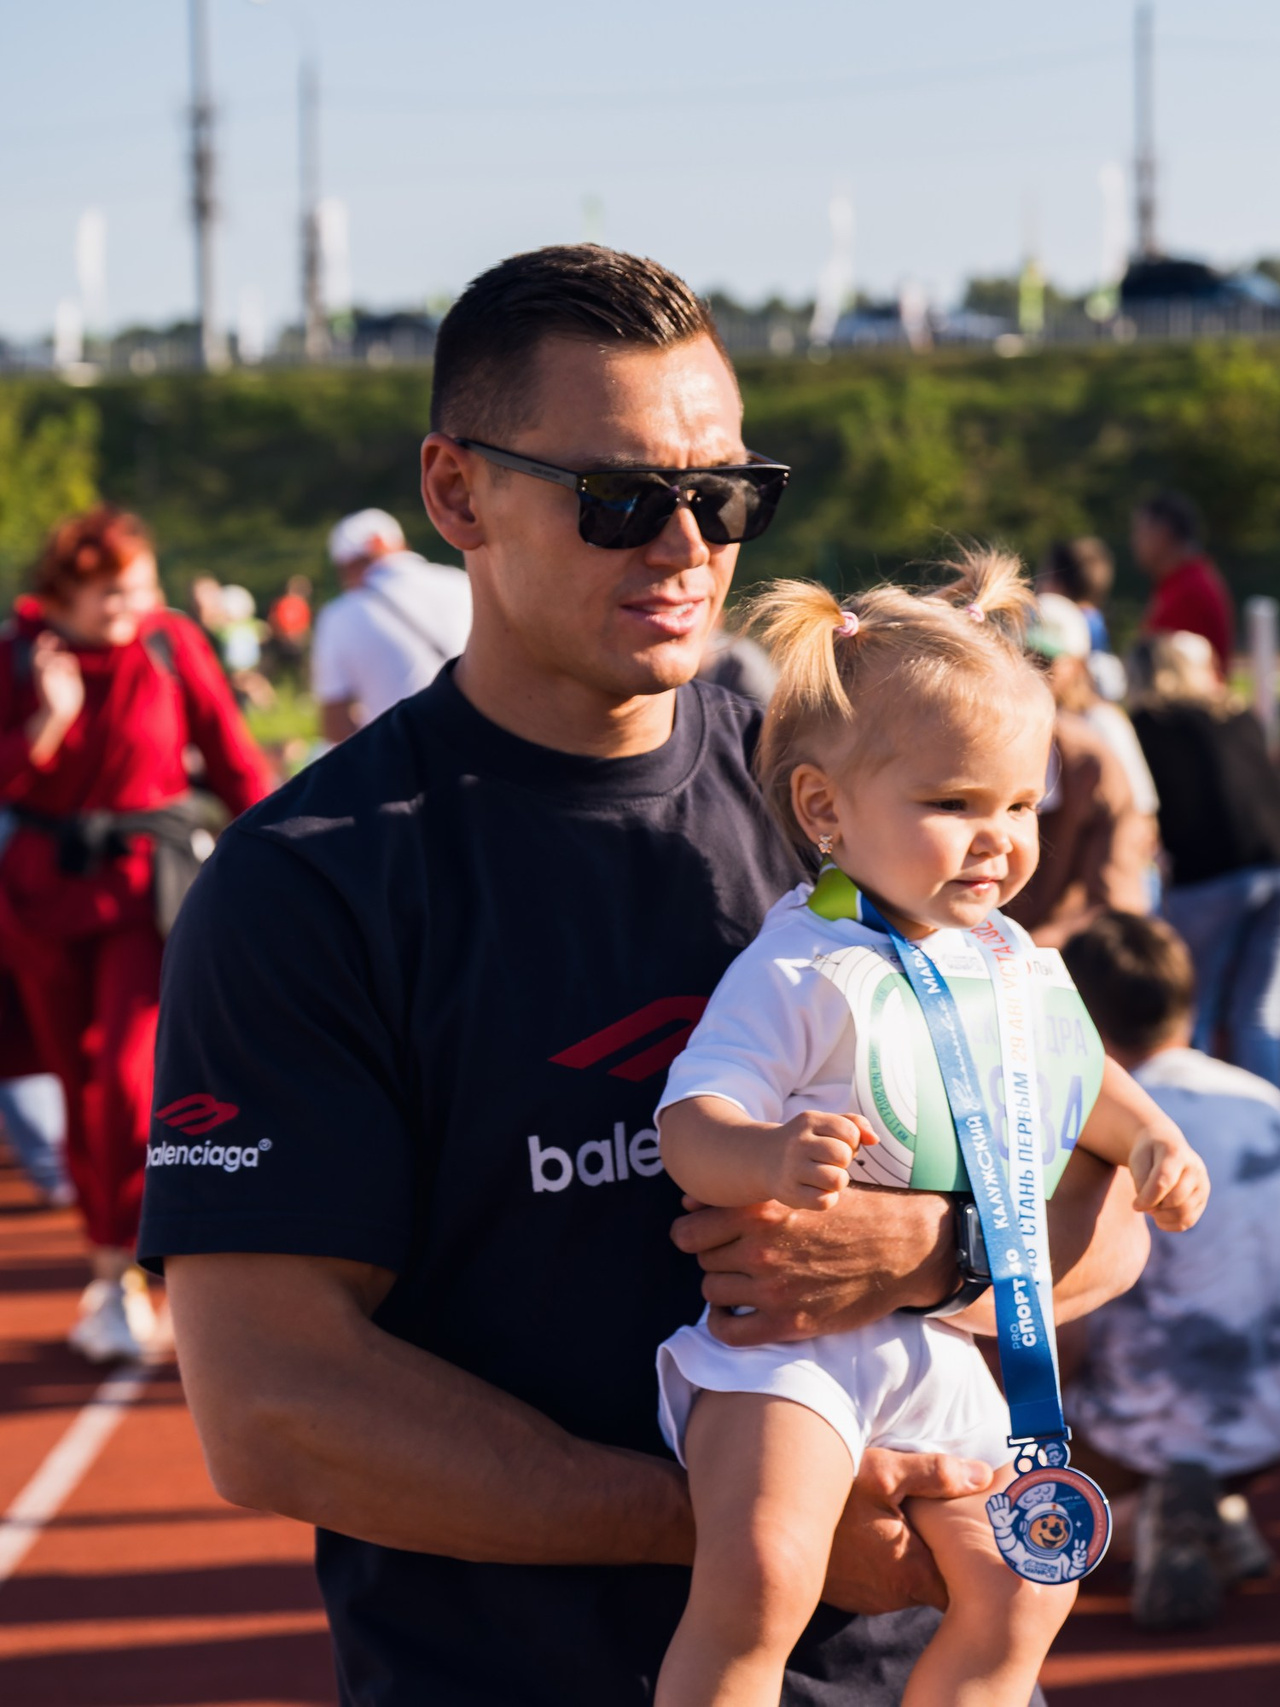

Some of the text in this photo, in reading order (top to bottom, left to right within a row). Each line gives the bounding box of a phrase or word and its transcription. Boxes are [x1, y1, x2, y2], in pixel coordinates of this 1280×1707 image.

[909, 945, 941, 994] МАРА
[1010, 1036, 1027, 1062] 29
[1013, 1071, 1033, 1162] ПЕРВЫМ
[965, 1114, 1010, 1230] КАЛУЖСКИЙ
[1017, 1168, 1037, 1236] СТАНЬ
[1010, 1322, 1021, 1351] PRO
[1013, 1277, 1037, 1348] СПОРТ
